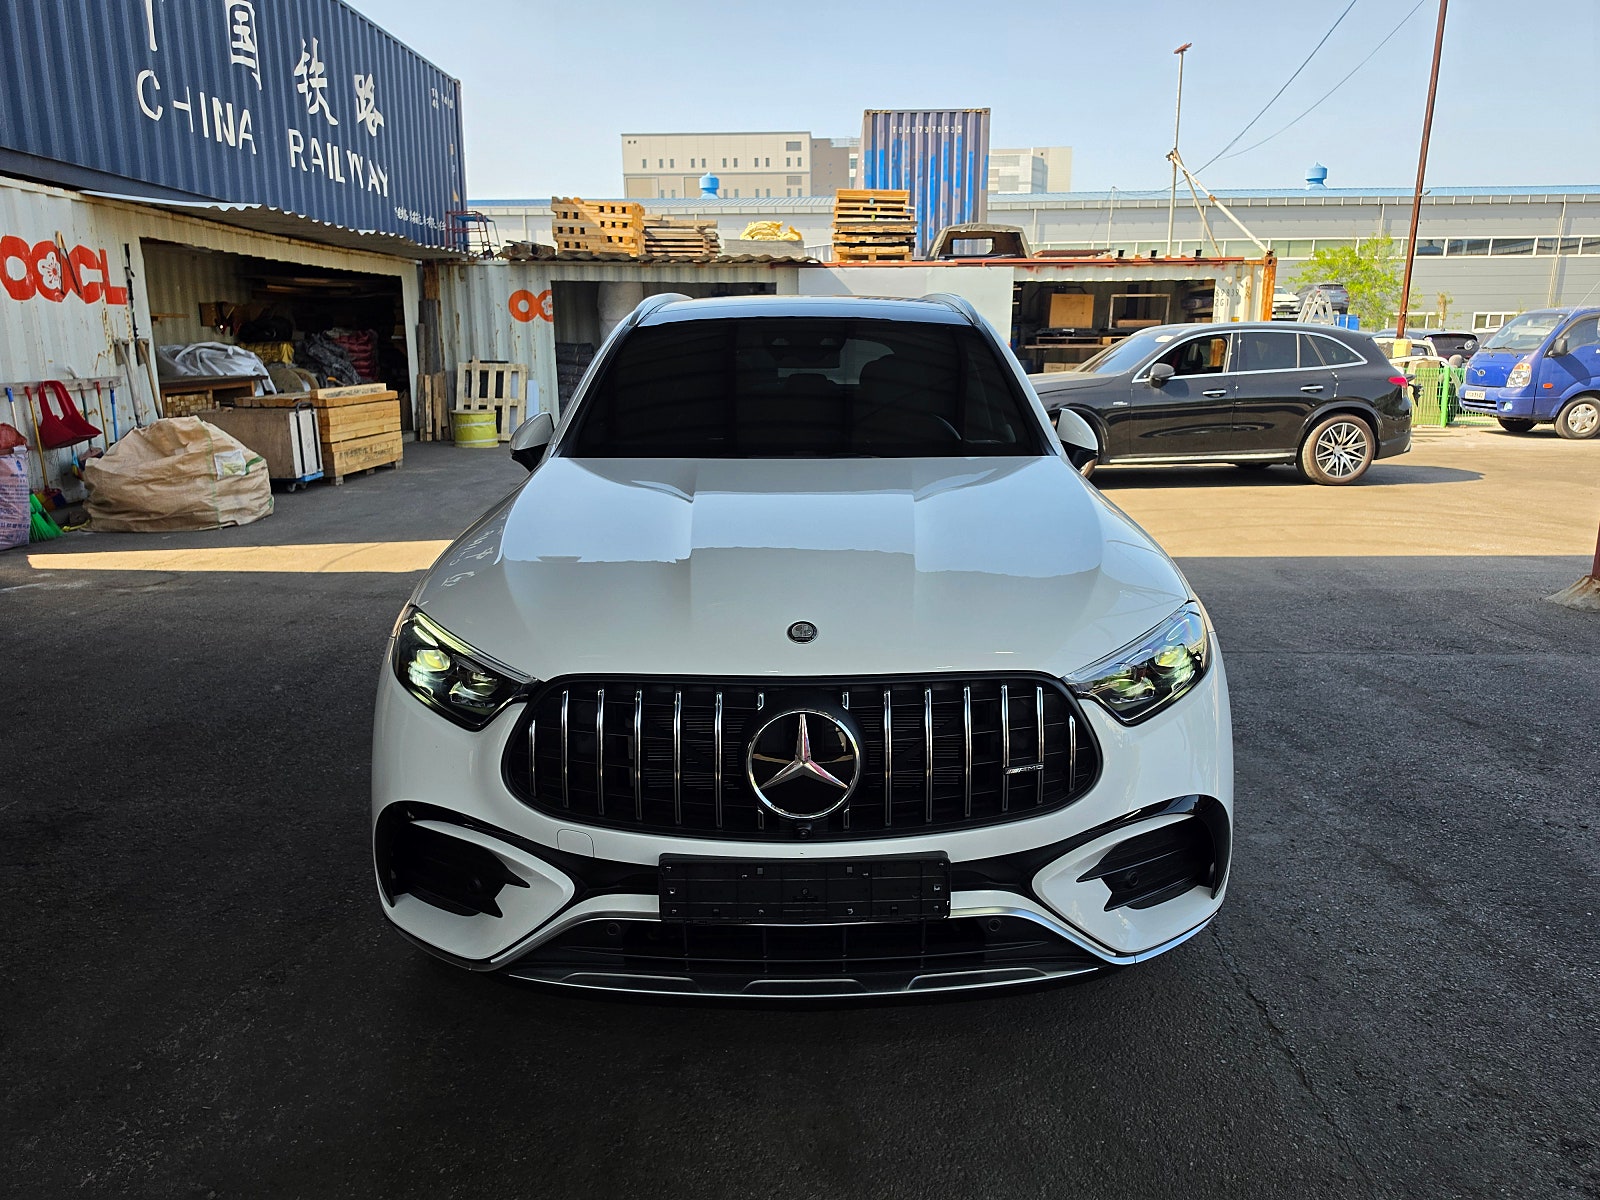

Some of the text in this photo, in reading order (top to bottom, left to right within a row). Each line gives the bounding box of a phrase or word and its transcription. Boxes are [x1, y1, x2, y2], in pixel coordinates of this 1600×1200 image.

[137, 69, 388, 197] CHINA RAILWAY
[0, 235, 128, 305] OOCL
